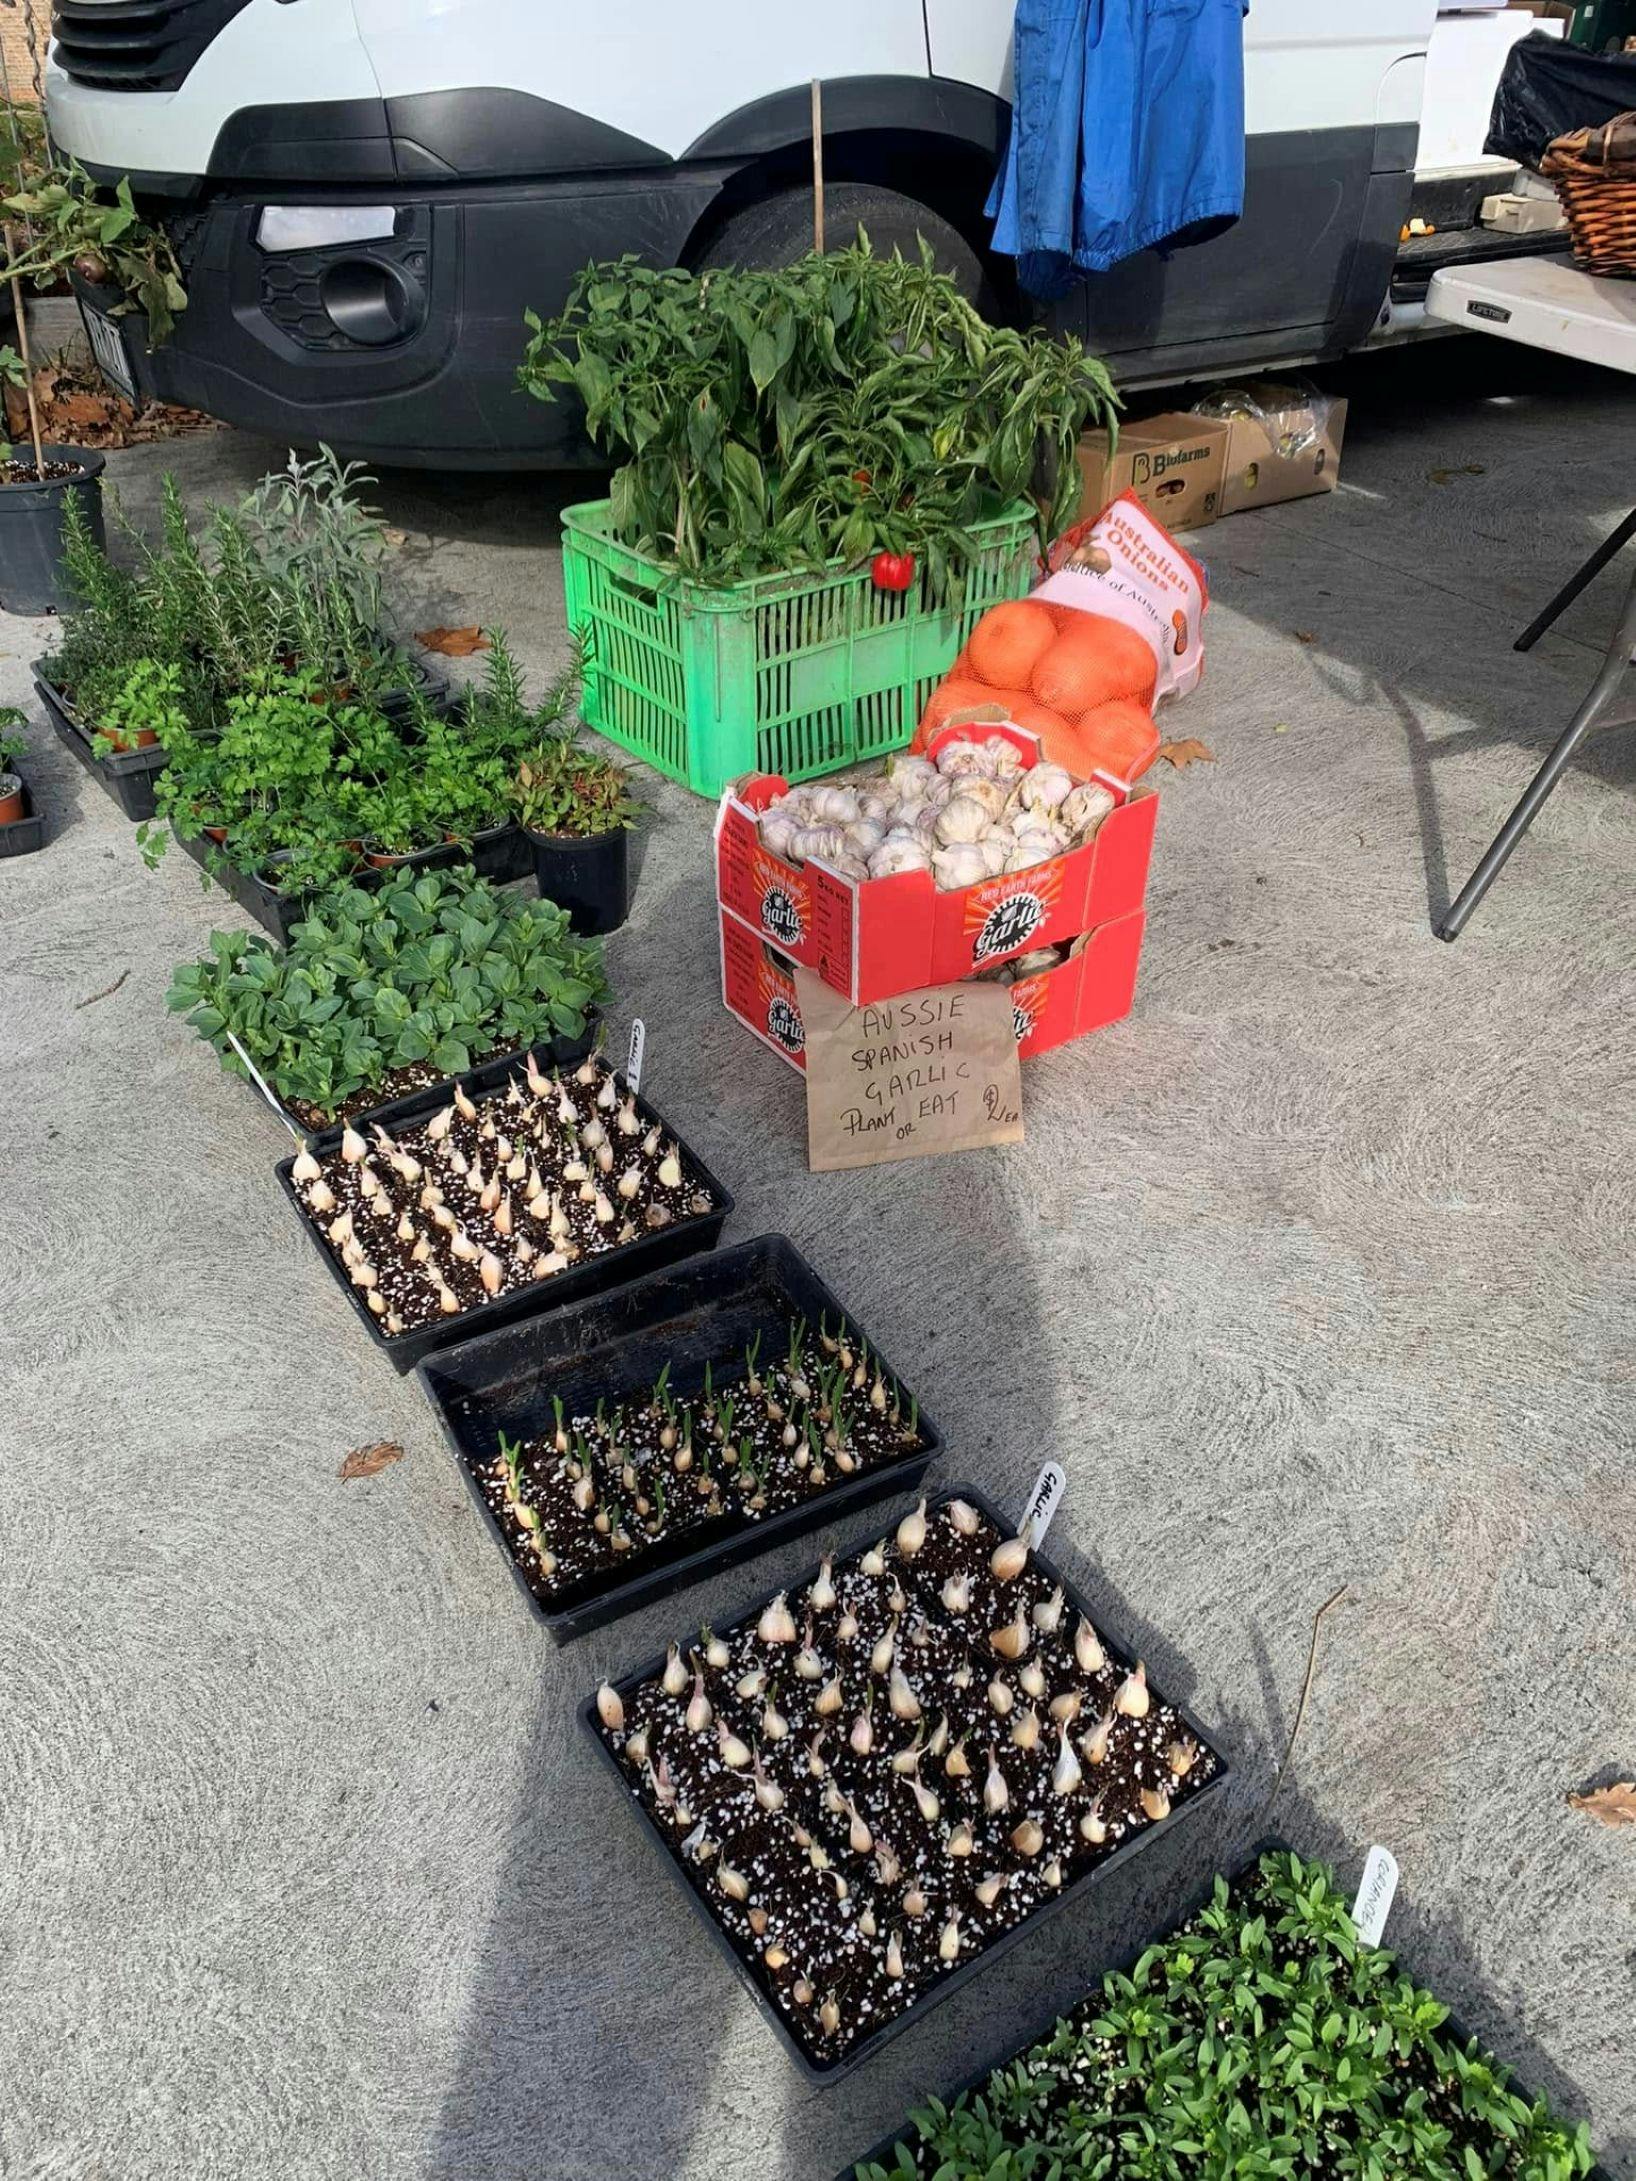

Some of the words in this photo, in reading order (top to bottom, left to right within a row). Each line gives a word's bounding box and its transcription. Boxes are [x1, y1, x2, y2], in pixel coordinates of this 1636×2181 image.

[1152, 446, 1211, 477] Biofarms
[1102, 512, 1190, 595] Australian
[1106, 528, 1169, 592] Onions
[1109, 577, 1127, 595] of
[761, 899, 804, 928] Garlic
[974, 901, 1046, 958] Garlic
[863, 994, 965, 1037] AUSSIE
[851, 1031, 953, 1071] SPANISH
[865, 1057, 970, 1105] GARLIC
[840, 1107, 896, 1136] PLANT
[896, 1122, 917, 1140] OR
[919, 1091, 959, 1118] EAT
[1032, 1472, 1057, 1518] GARLIC
